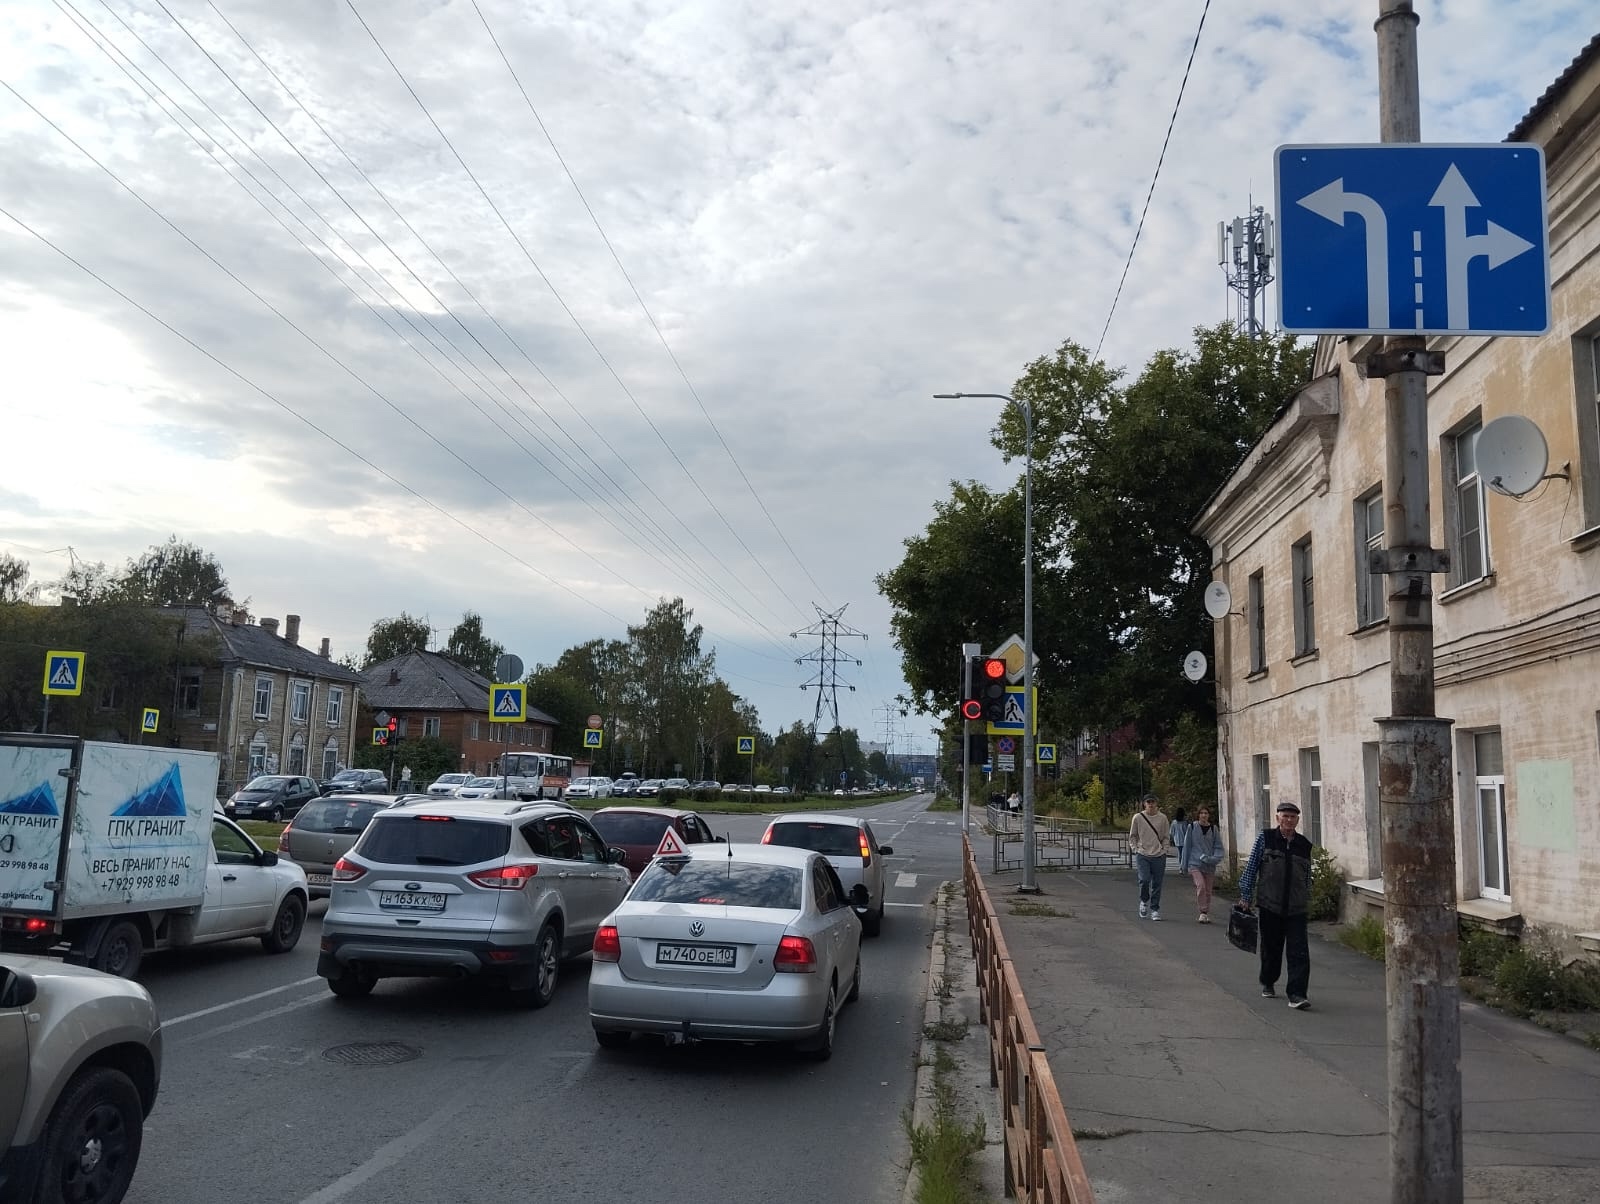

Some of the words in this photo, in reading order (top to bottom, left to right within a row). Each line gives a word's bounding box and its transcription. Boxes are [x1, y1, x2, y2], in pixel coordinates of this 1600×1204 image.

[12, 815, 60, 829] ГРАНИТ
[107, 820, 135, 836] ГПК
[137, 820, 186, 836] ГРАНИТ
[12, 860, 26, 870] 998
[28, 861, 38, 870] 98
[39, 862, 49, 871] 48
[92, 859, 120, 873] ВЕСЬ
[122, 857, 161, 872] ГРАНИТ
[163, 857, 170, 870] У
[171, 856, 191, 869] НАС
[101, 878, 114, 891] +7
[116, 877, 135, 891] 929
[136, 875, 153, 889] 998
[156, 874, 167, 888] 98
[168, 874, 180, 887] 48
[432, 894, 442, 903] 10
[718, 948, 731, 960] 10
